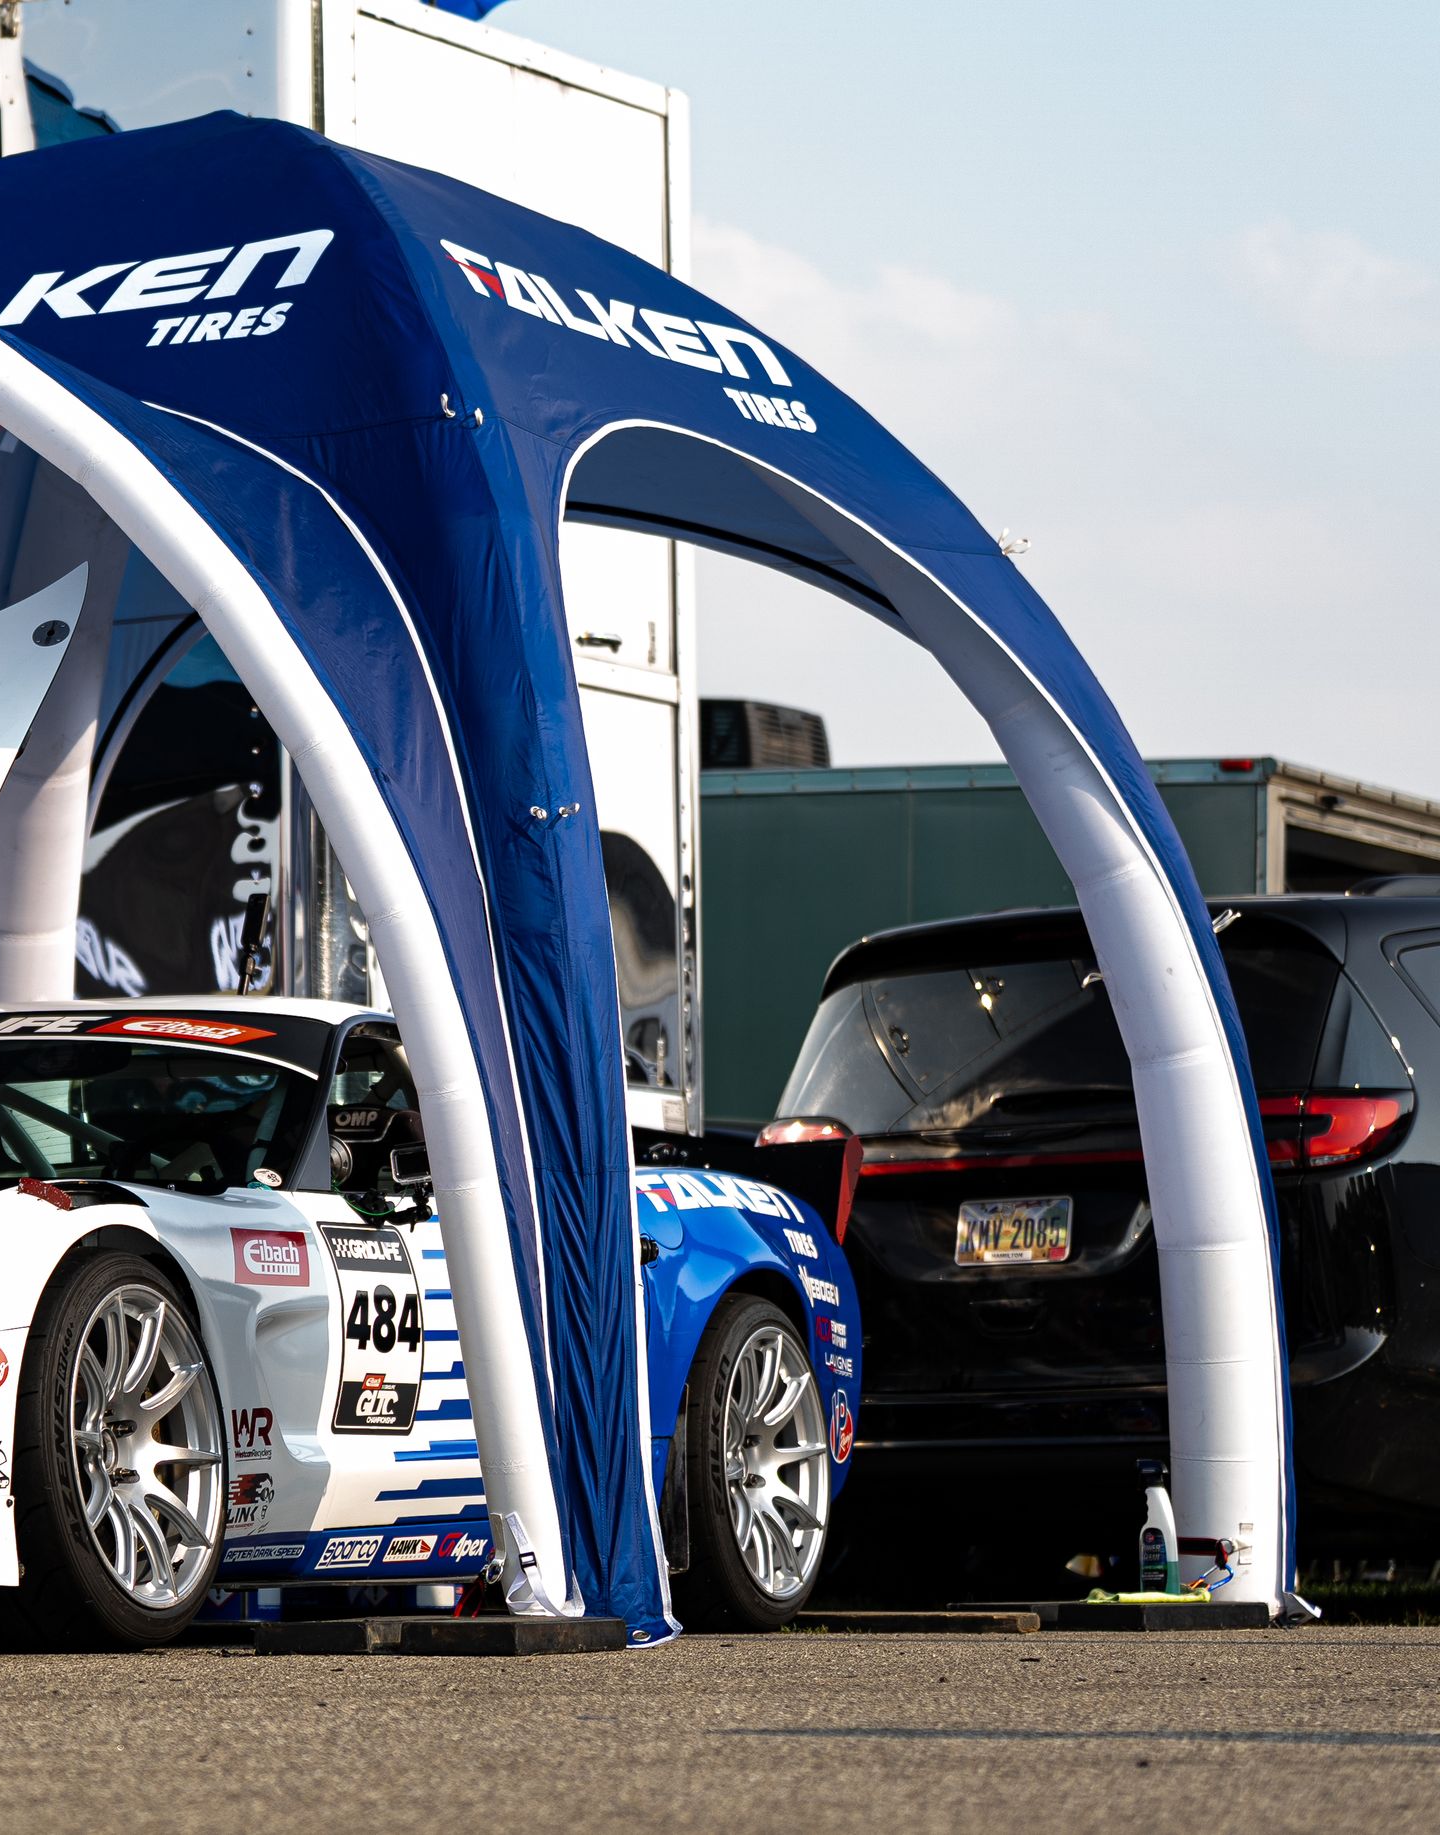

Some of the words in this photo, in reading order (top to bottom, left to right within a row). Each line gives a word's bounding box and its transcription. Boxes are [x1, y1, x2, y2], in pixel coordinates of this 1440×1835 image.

[146, 302, 294, 347] TIRES
[439, 238, 793, 387] FALKEN
[723, 386, 817, 433] TIRES
[122, 1019, 242, 1040] Eibach
[334, 1110, 378, 1127] OMP
[636, 1173, 805, 1224] FALKEN
[782, 1228, 818, 1260] TIRES
[965, 1219, 1003, 1252] KMV
[1011, 1216, 1060, 1249] 2085
[243, 1240, 300, 1273] Eibach
[347, 1238, 403, 1262] GRIDLIFE
[346, 1284, 422, 1354] 484
[825, 1352, 853, 1373] LAVIGNE
[226, 1506, 259, 1524] LINK
[225, 1548, 252, 1561] AFTER
[323, 1538, 379, 1567] sparco
[388, 1539, 420, 1555] HAWK
[450, 1532, 488, 1562] Apex
